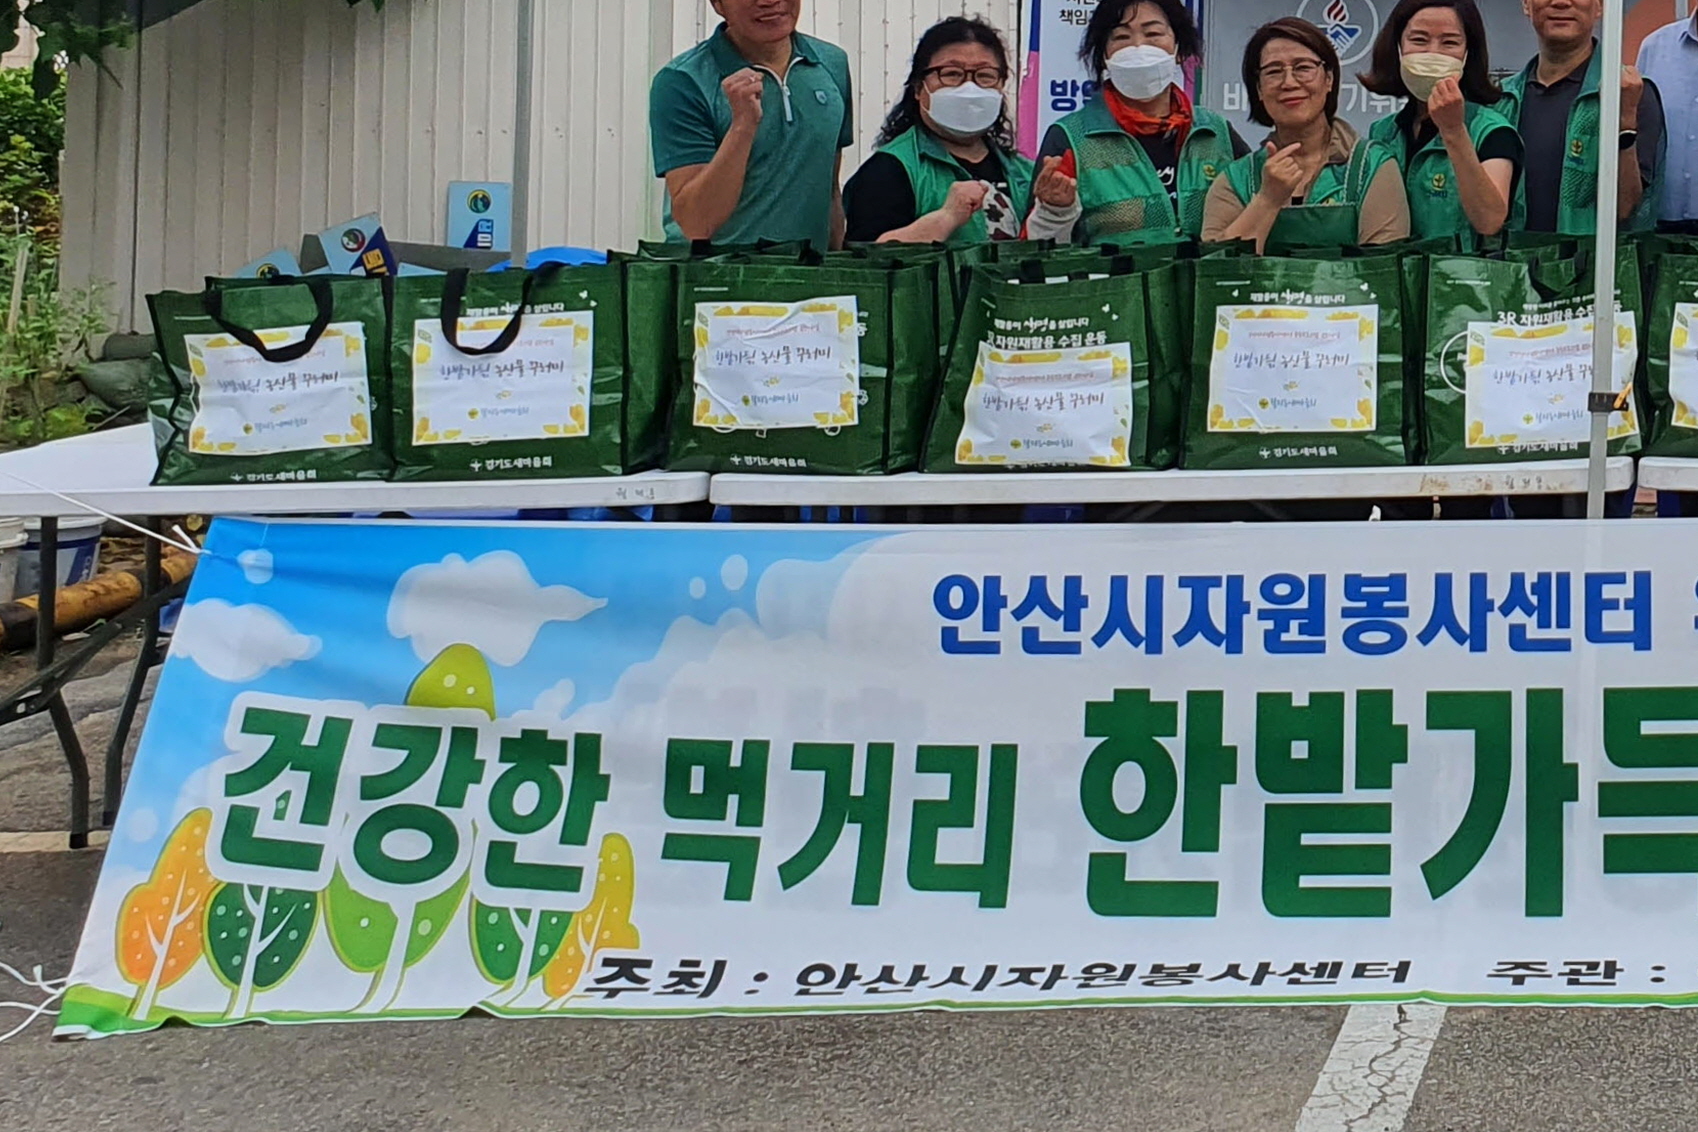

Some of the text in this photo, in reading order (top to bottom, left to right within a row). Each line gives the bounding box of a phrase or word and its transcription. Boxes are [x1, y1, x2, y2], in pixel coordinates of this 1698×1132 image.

[1059, 9, 1093, 25] 책임
[1497, 311, 1516, 325] 3R
[1058, 334, 1082, 348] 수집
[933, 570, 1652, 656] 안산시자원봉사센터
[220, 706, 611, 894] 건강한
[661, 737, 1019, 909] 먹거리
[584, 957, 727, 999] 주최
[794, 958, 1412, 998] 안산시자원봉사센터
[1487, 959, 1624, 988] 주관
